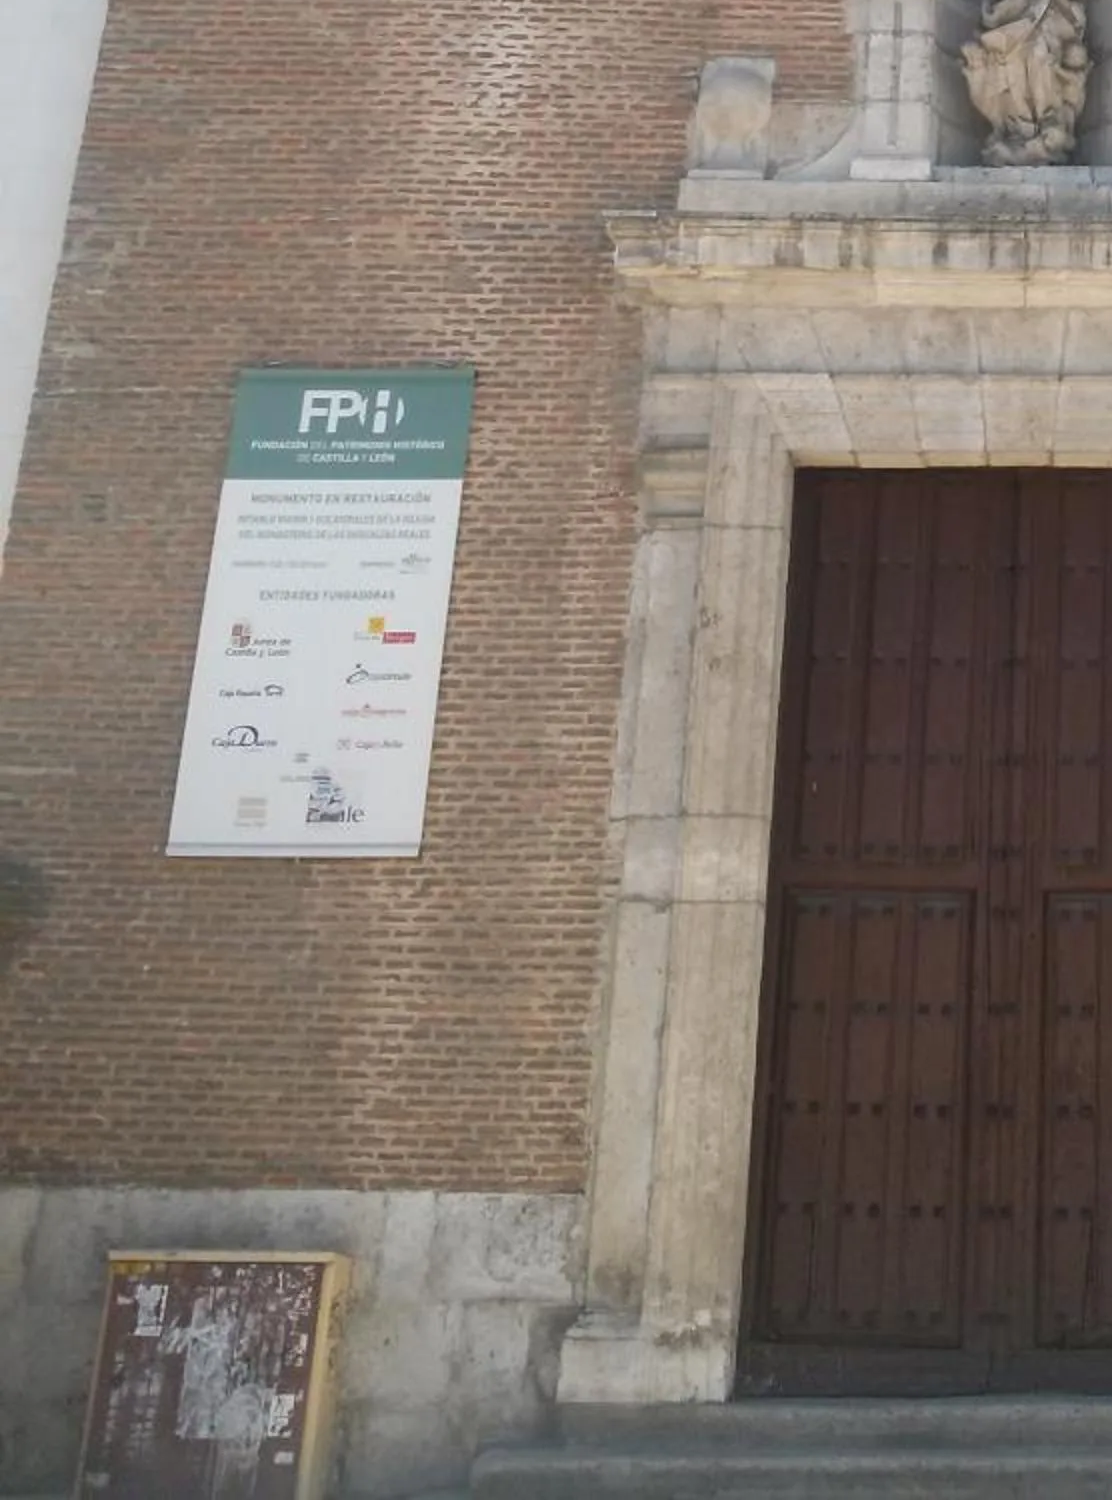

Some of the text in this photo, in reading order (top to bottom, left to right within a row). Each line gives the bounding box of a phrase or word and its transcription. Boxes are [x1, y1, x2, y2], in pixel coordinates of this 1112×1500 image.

[250, 439, 309, 450] FUNDACIÓN
[393, 440, 445, 450] HISTÓRICO
[312, 454, 360, 463] CASTILLA
[368, 453, 396, 463] LEÓN
[251, 492, 322, 504] MONUMENTO
[342, 492, 432, 503] RESTAURACIÓN
[259, 589, 396, 601] ENTIDADES FUNDADORAS
